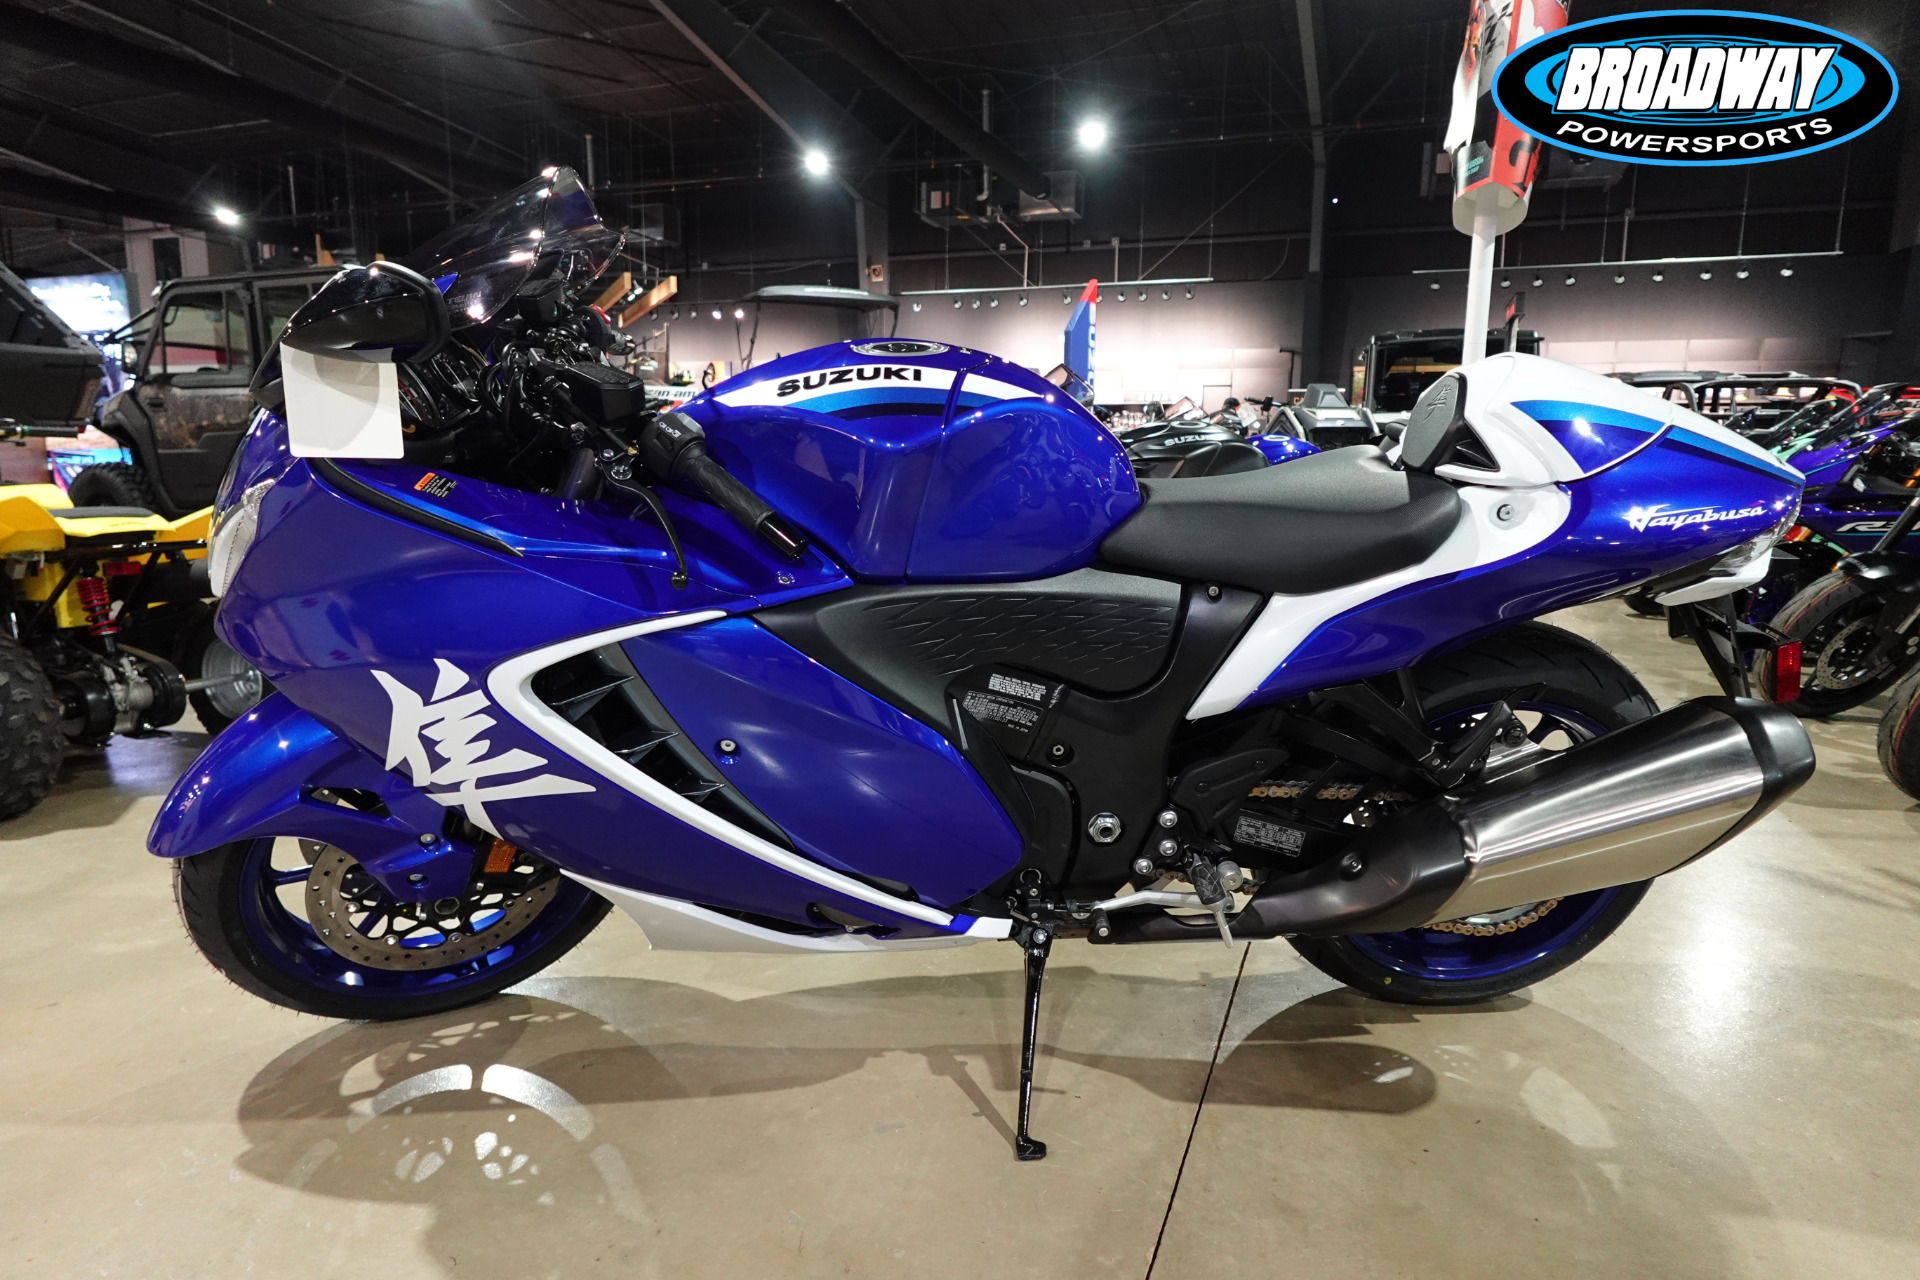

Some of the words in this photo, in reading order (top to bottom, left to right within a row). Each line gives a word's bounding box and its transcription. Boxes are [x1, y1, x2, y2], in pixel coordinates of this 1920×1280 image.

[776, 366, 922, 398] SUZUKI
[1622, 503, 1768, 533] Hayabusa
[370, 657, 597, 840] 隼
